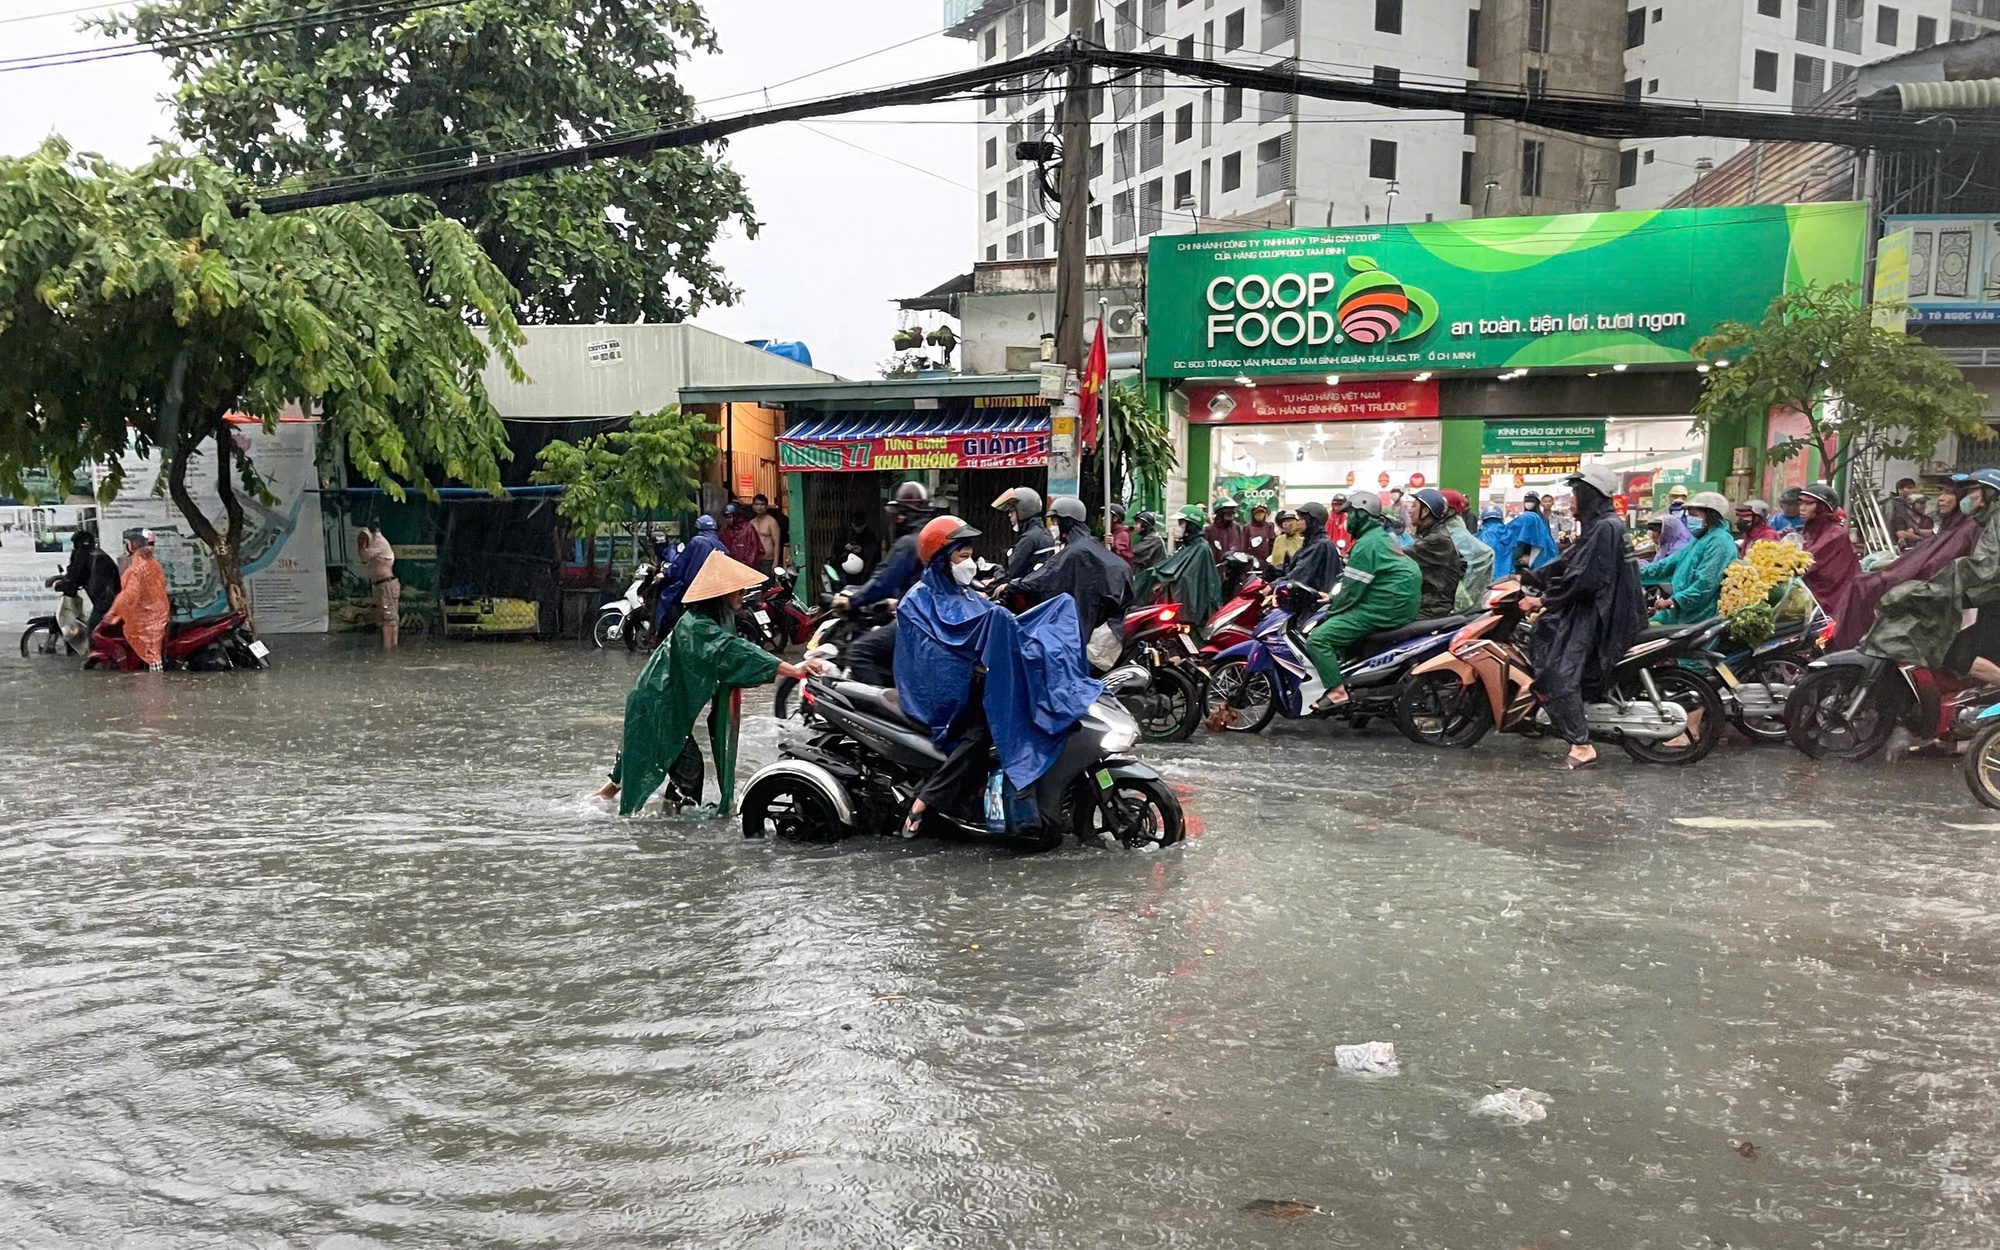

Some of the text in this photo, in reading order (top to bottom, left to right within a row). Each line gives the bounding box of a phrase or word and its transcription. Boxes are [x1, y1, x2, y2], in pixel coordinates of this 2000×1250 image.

[1177, 243, 1191, 251] CHI
[1193, 239, 1223, 250] NHÁNH
[1223, 239, 1247, 249] CÔNG
[1248, 240, 1260, 248] TY
[1263, 238, 1286, 247] TNHH
[1286, 237, 1306, 246] MTV
[1308, 237, 1320, 245] TP
[1306, 248, 1325, 256] TAM
[1325, 246, 1346, 256] BÌNH
[1206, 272, 1335, 311] CO.OP
[1451, 321, 1473, 336] an
[1638, 312, 1686, 332] ngon
[1299, 357, 1317, 365] TAM
[1452, 351, 1476, 361] MINH
[1360, 391, 1381, 400] NAM
[964, 432, 1028, 457] GIẢM
[847, 442, 871, 467] 77
[874, 454, 905, 470] KHAI
[1006, 457, 1016, 466] 21
